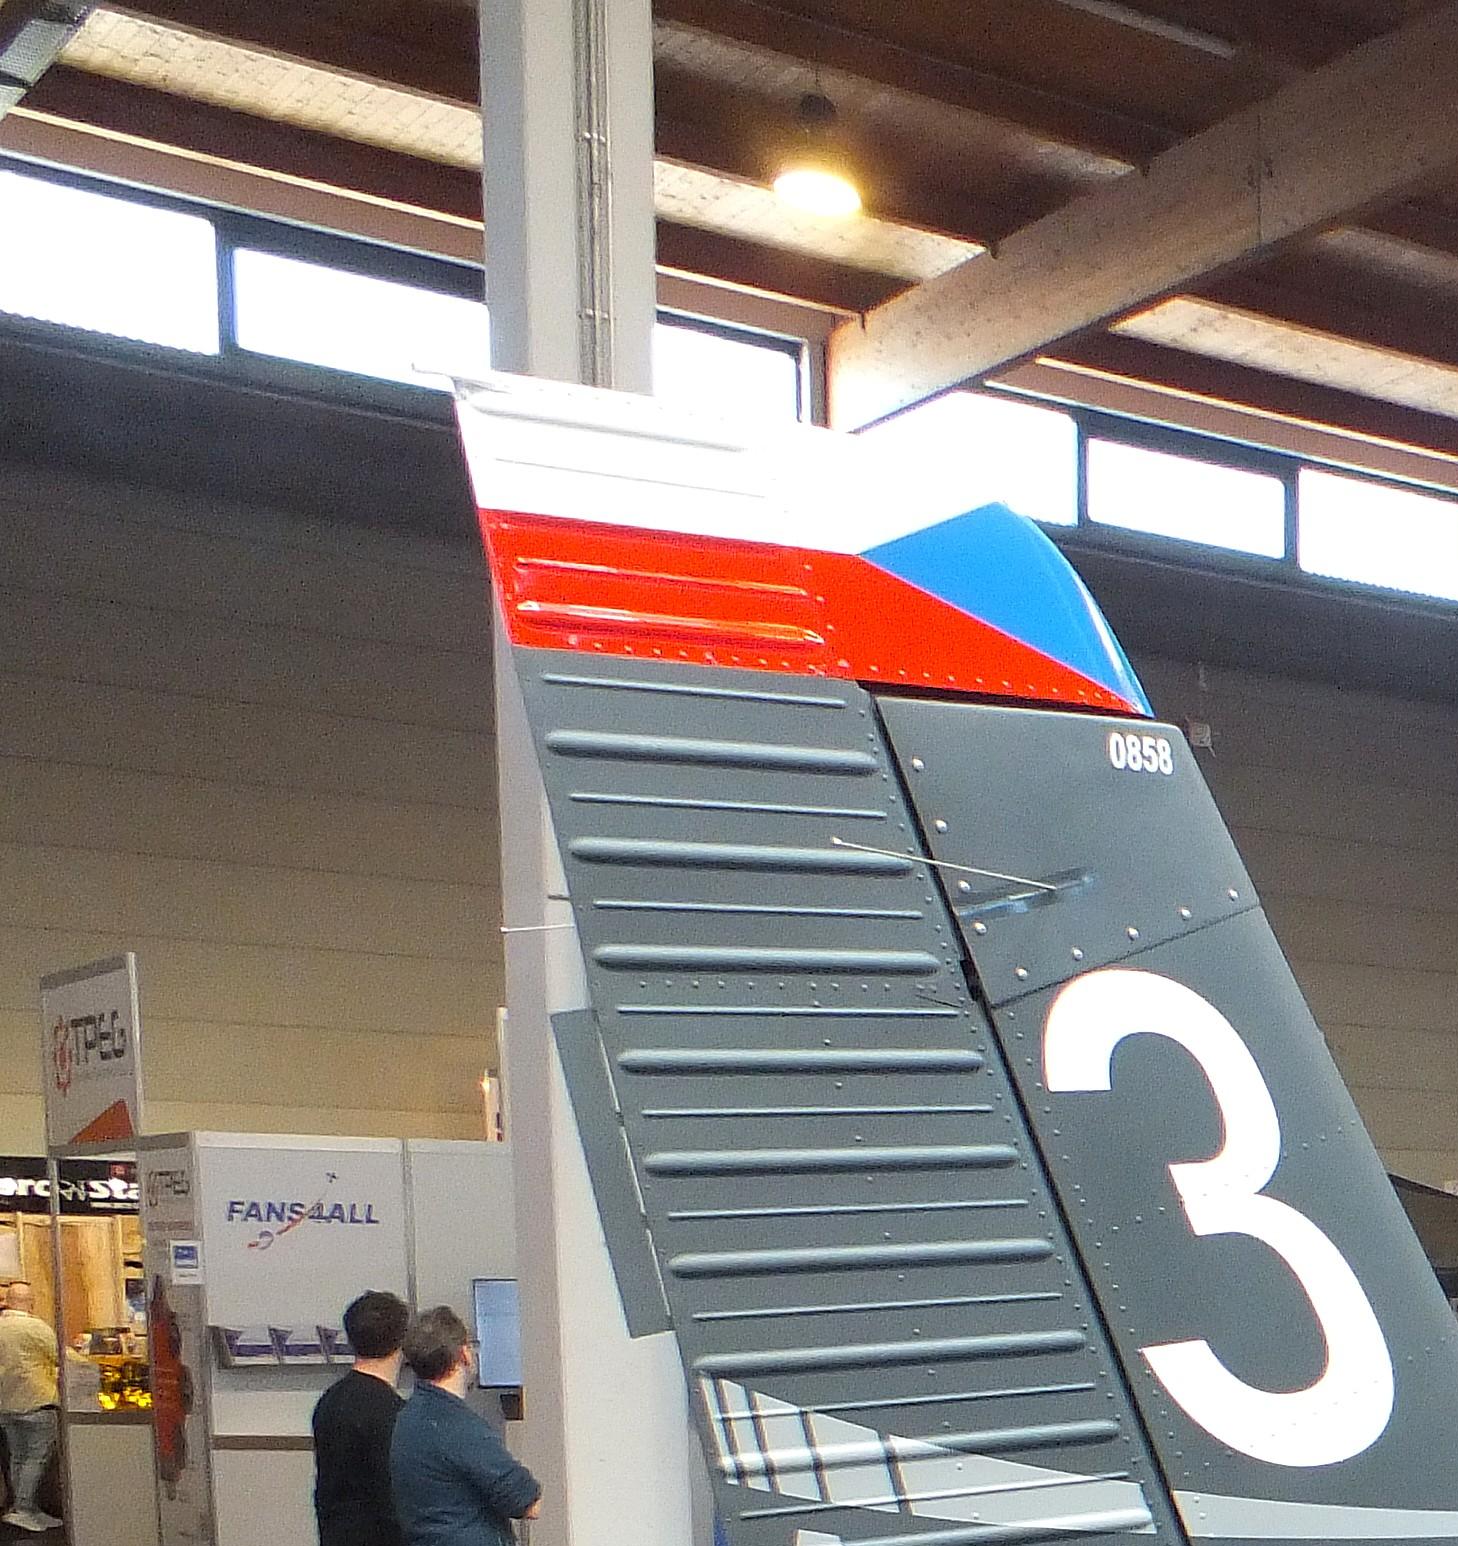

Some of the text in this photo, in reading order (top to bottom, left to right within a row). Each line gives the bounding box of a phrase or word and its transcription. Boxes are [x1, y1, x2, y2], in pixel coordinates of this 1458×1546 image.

[1109, 732, 1173, 775] 0858
[227, 1200, 380, 1224] FANS4ALL
[1044, 968, 1394, 1467] 3
